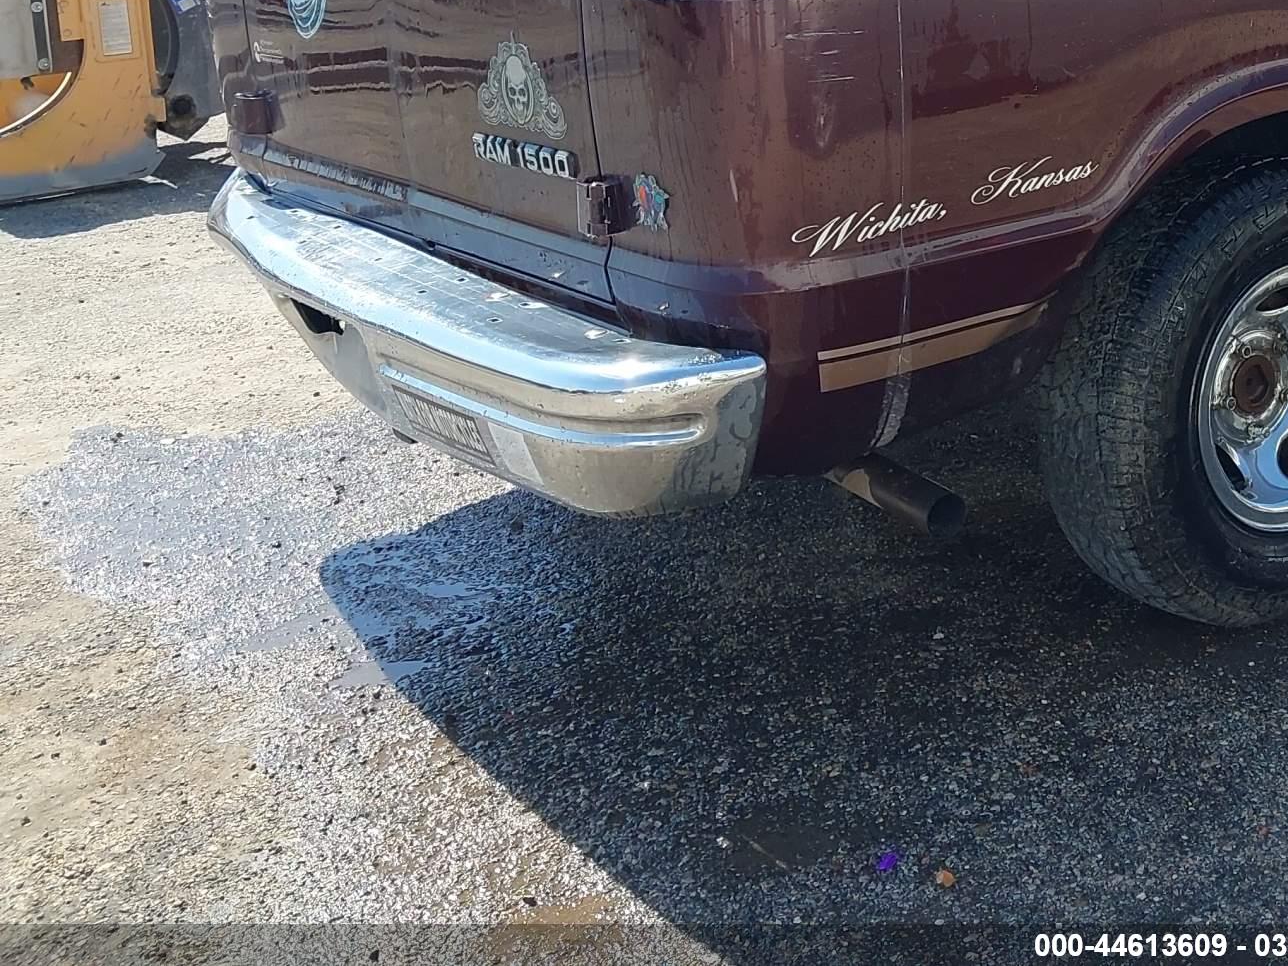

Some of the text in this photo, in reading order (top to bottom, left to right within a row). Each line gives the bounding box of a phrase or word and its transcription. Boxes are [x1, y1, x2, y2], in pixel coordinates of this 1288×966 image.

[472, 132, 573, 178] RAM 1500
[791, 156, 1100, 257] Wichita, Kansas
